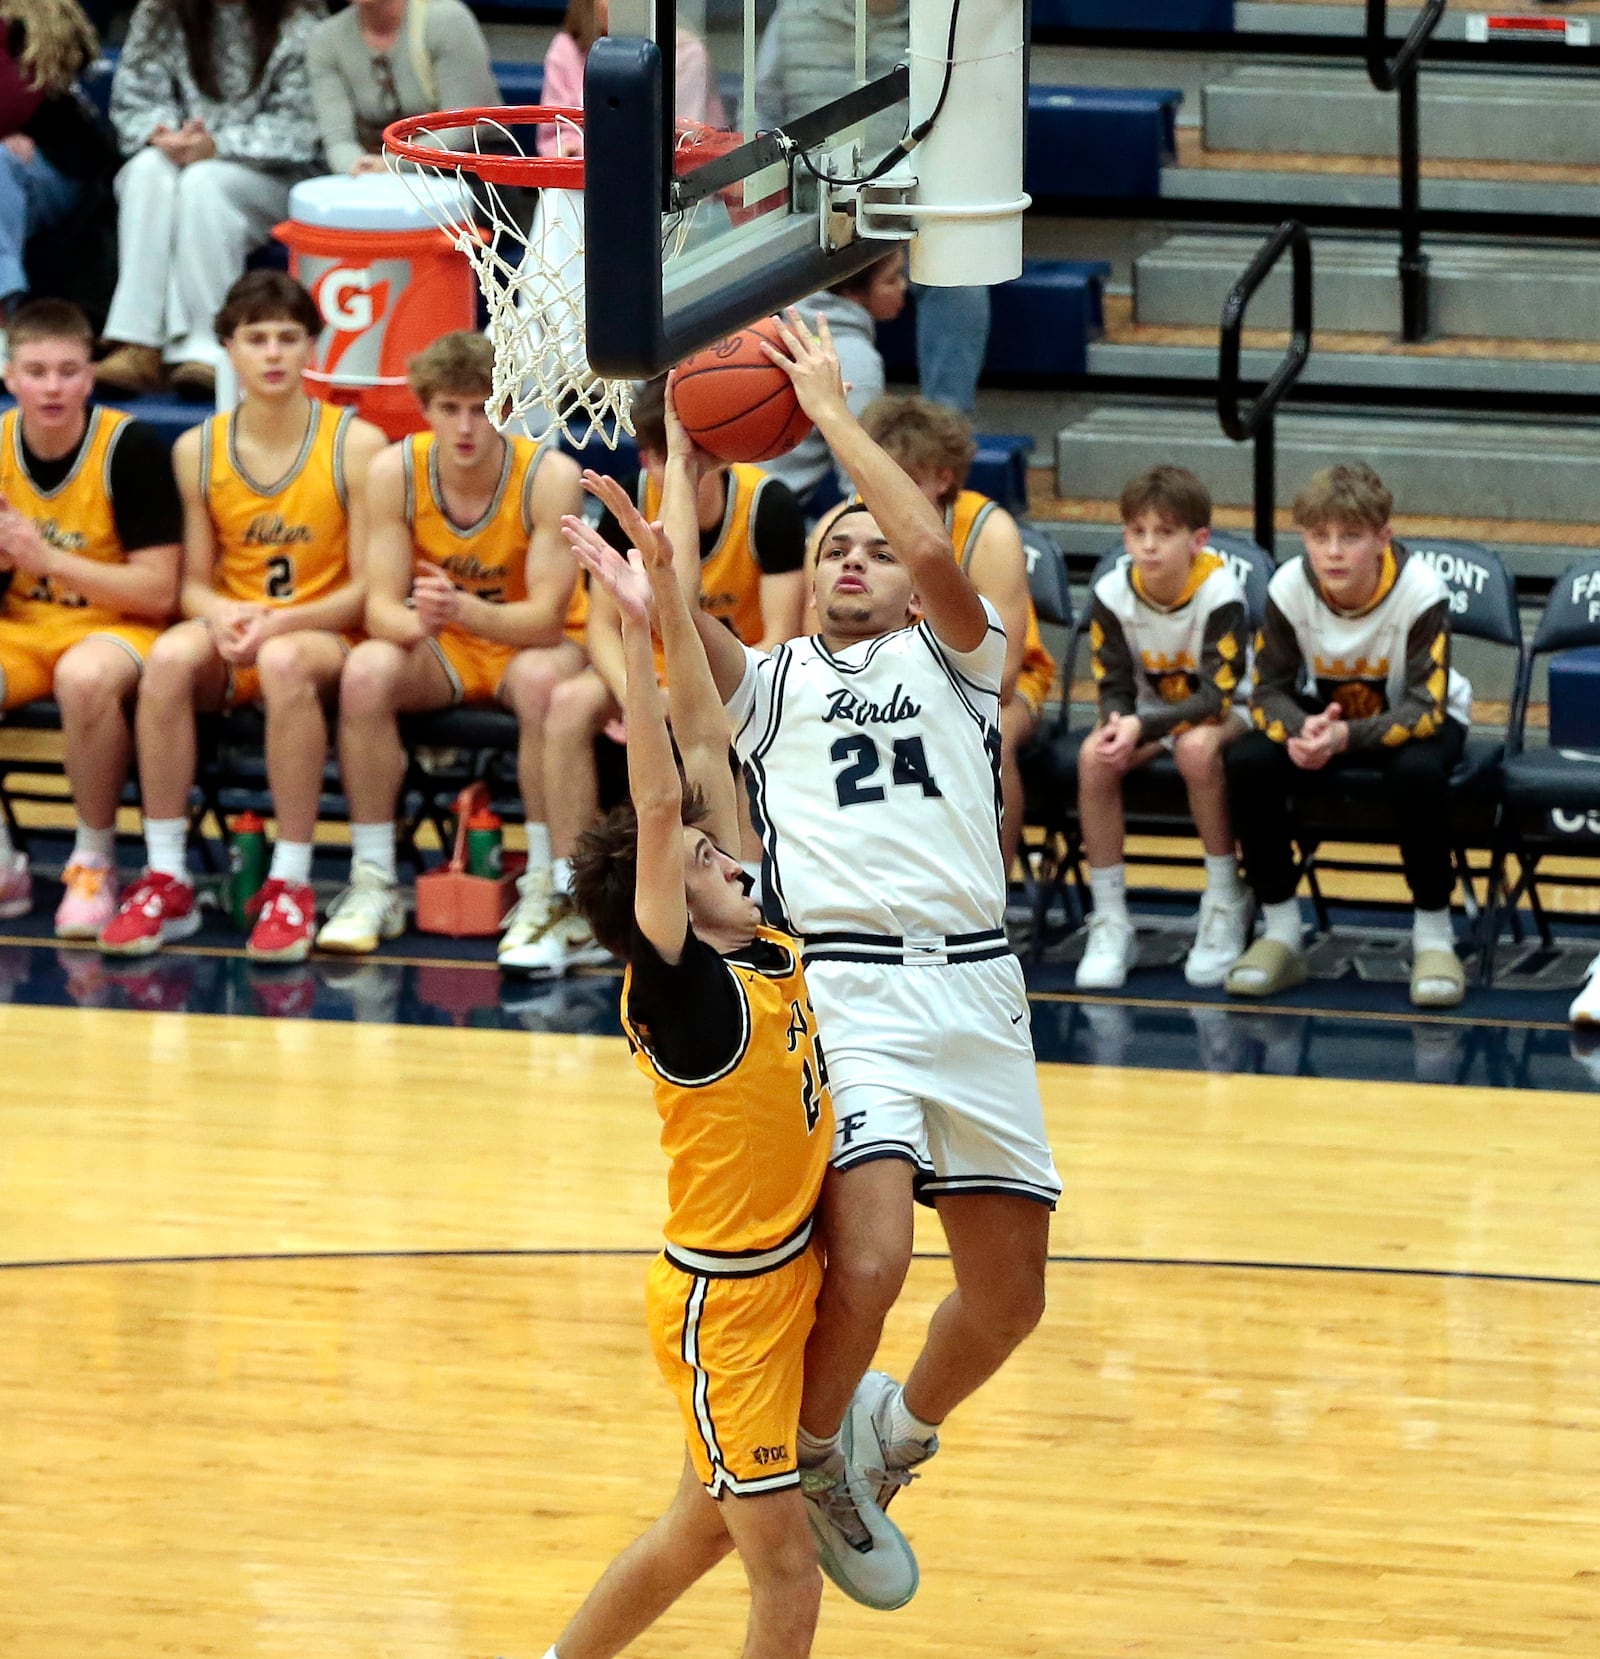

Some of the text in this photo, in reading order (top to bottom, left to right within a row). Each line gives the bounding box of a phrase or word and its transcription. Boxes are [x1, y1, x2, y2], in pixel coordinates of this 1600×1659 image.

[319, 267, 373, 331] G
[265, 556, 294, 599] 2
[821, 683, 922, 726] Birds
[828, 732, 945, 811] 24
[836, 1110, 867, 1146] F
